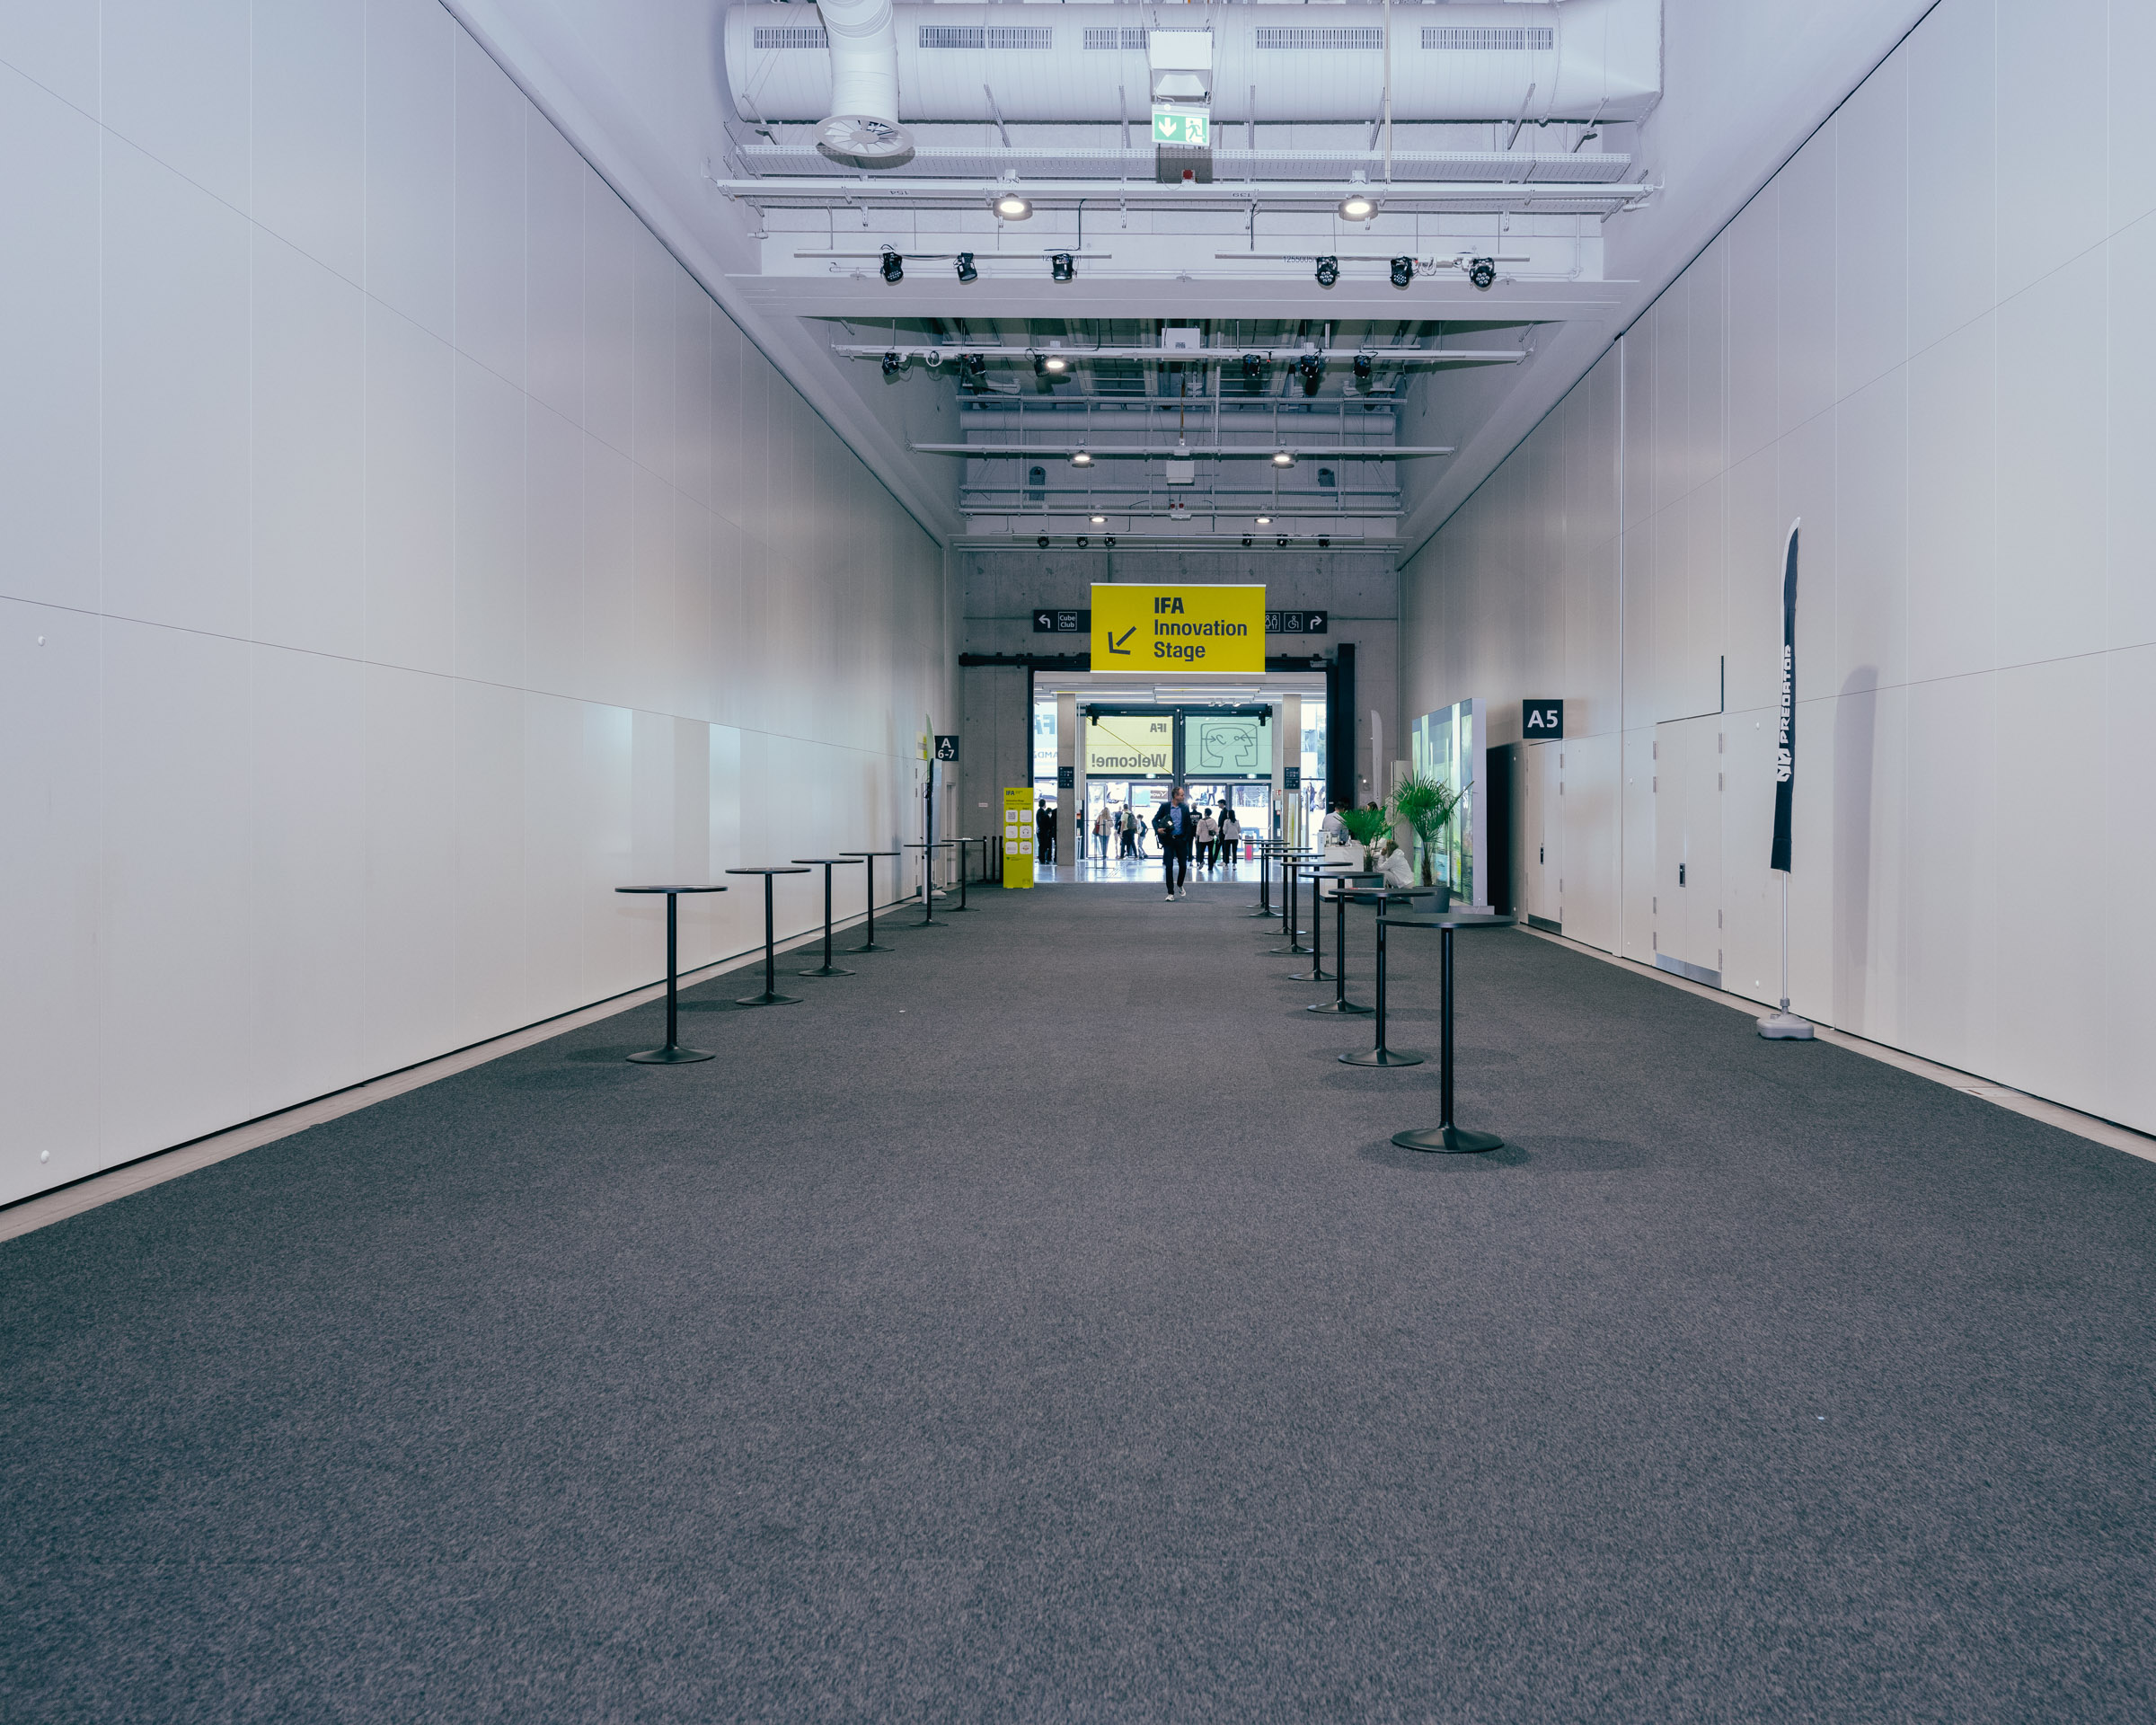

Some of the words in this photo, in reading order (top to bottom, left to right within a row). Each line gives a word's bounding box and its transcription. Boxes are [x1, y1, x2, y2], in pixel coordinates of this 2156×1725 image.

[1153, 597, 1185, 615] IFA
[1153, 619, 1248, 636] Innovation
[1153, 641, 1206, 661] Stage
[1527, 710, 1558, 728] A5
[941, 738, 951, 748] A
[937, 749, 955, 759] 6-7
